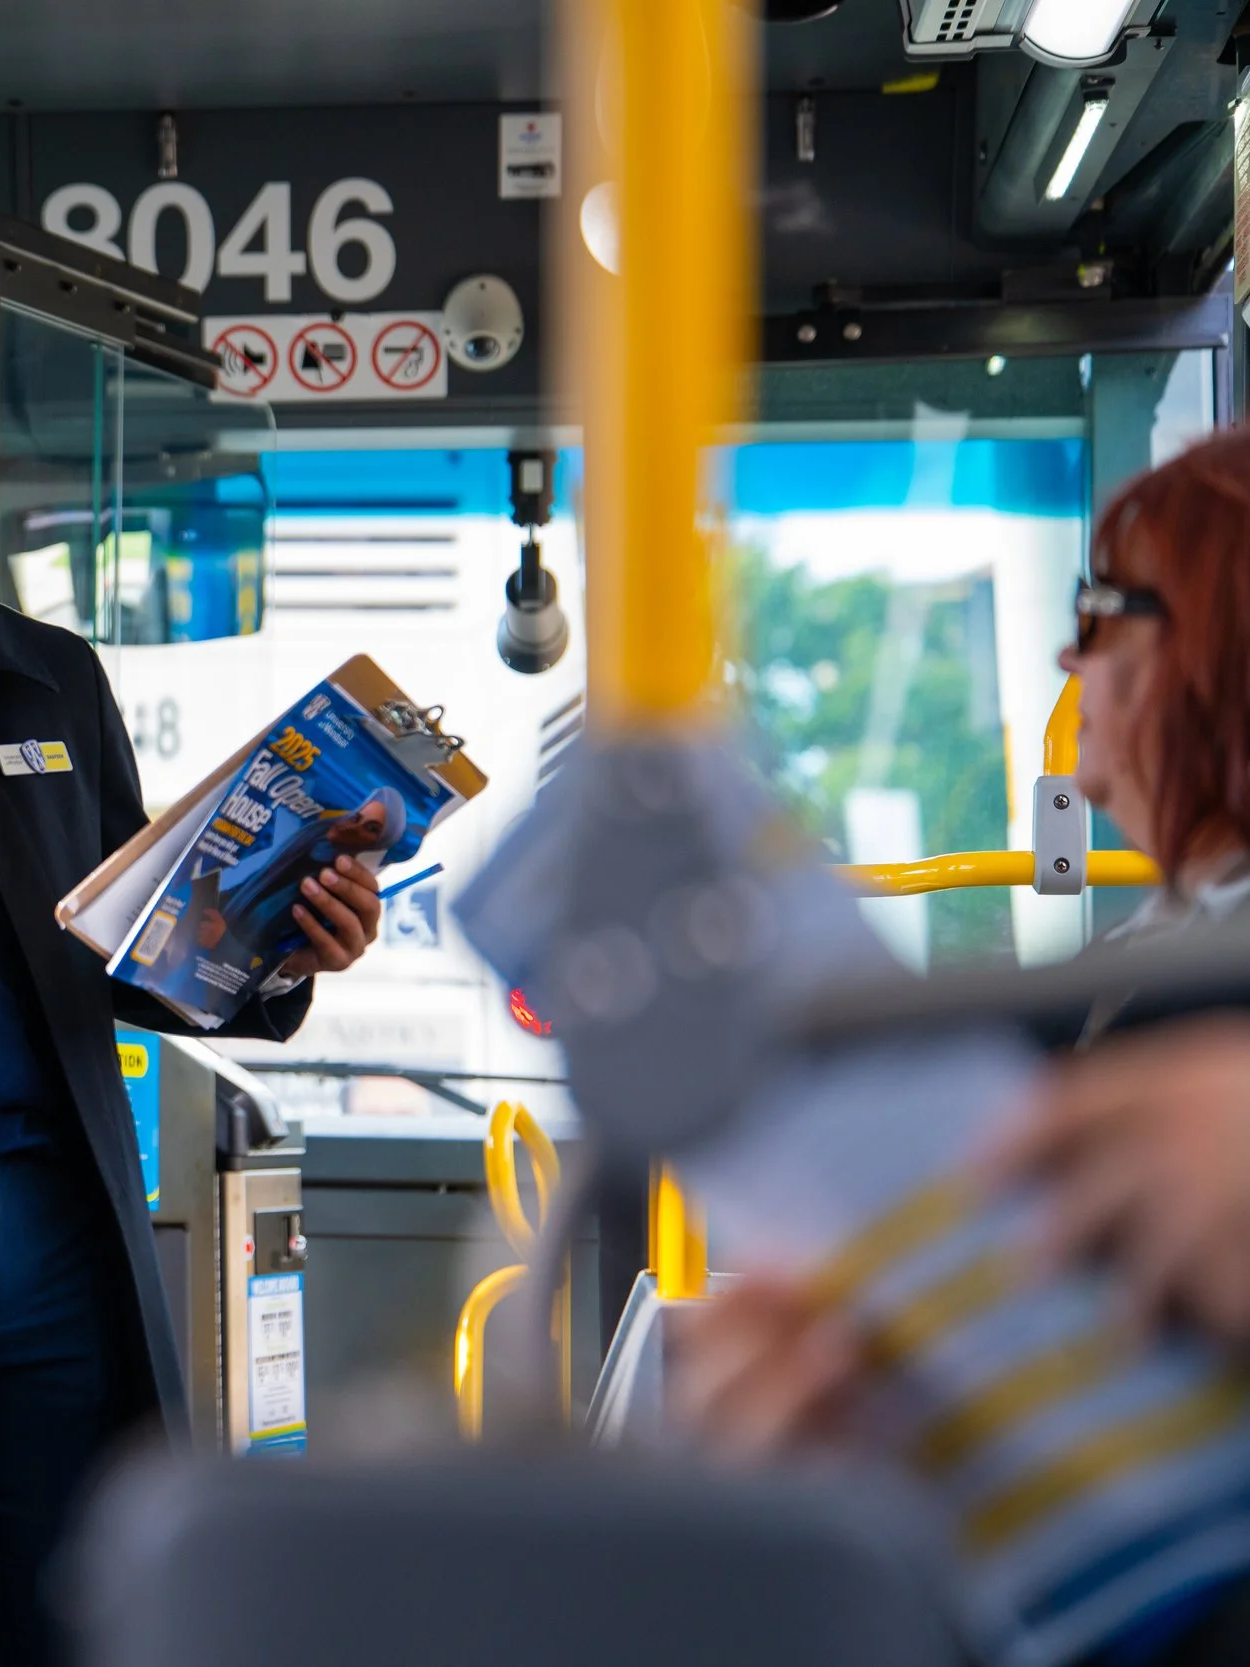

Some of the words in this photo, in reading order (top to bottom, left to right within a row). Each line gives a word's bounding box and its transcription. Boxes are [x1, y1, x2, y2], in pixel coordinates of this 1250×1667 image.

[42, 178, 396, 302] 8046
[269, 725, 322, 772] 2025
[221, 782, 272, 834] House
[243, 748, 288, 793] Fall
[269, 776, 326, 819] Open
